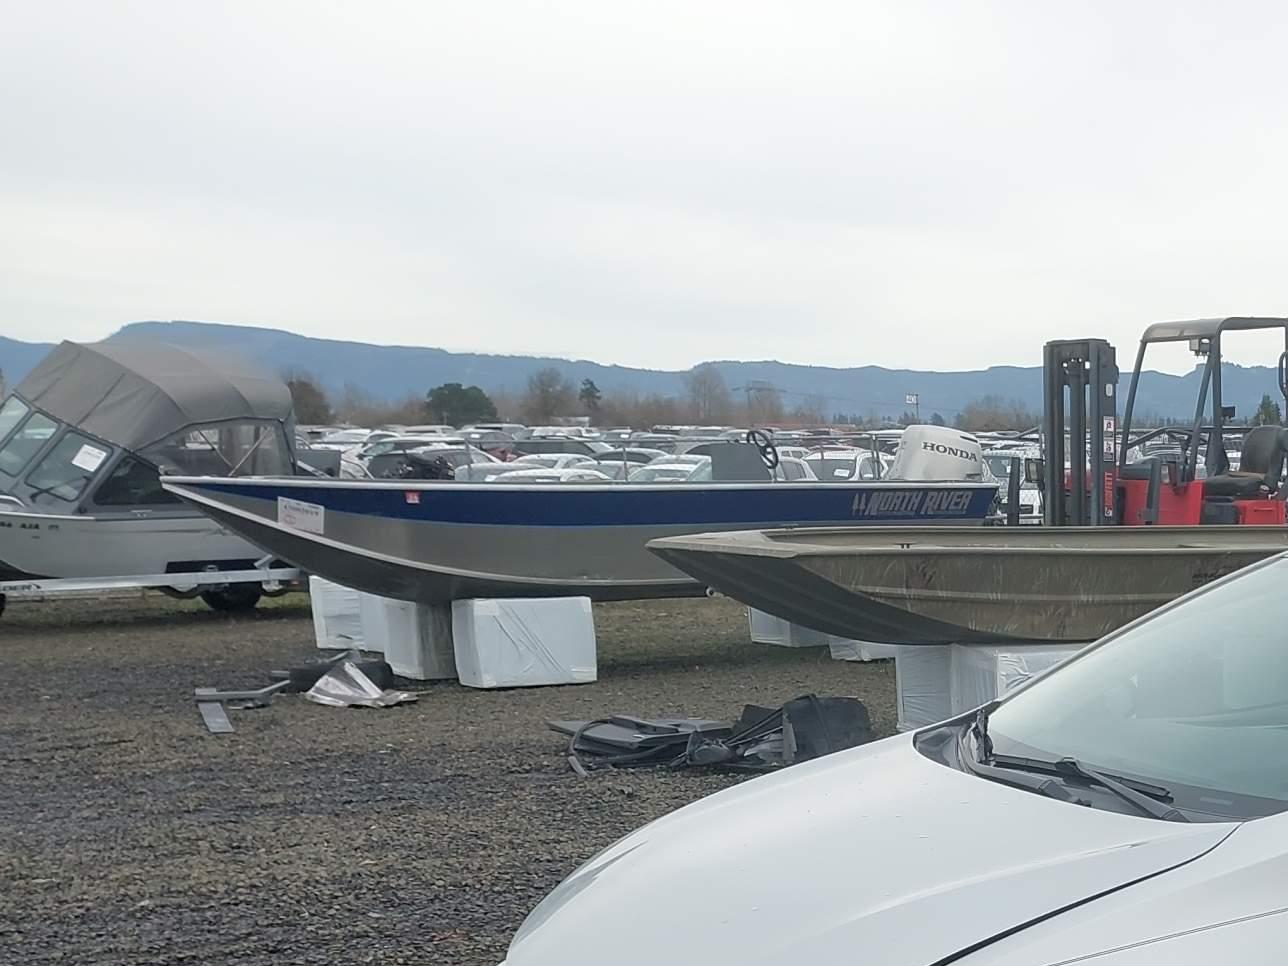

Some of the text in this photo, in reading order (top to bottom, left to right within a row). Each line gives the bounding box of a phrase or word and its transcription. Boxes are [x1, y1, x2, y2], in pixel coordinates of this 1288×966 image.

[922, 441, 978, 462] HONDA
[864, 490, 974, 516] NORTH RIVER
